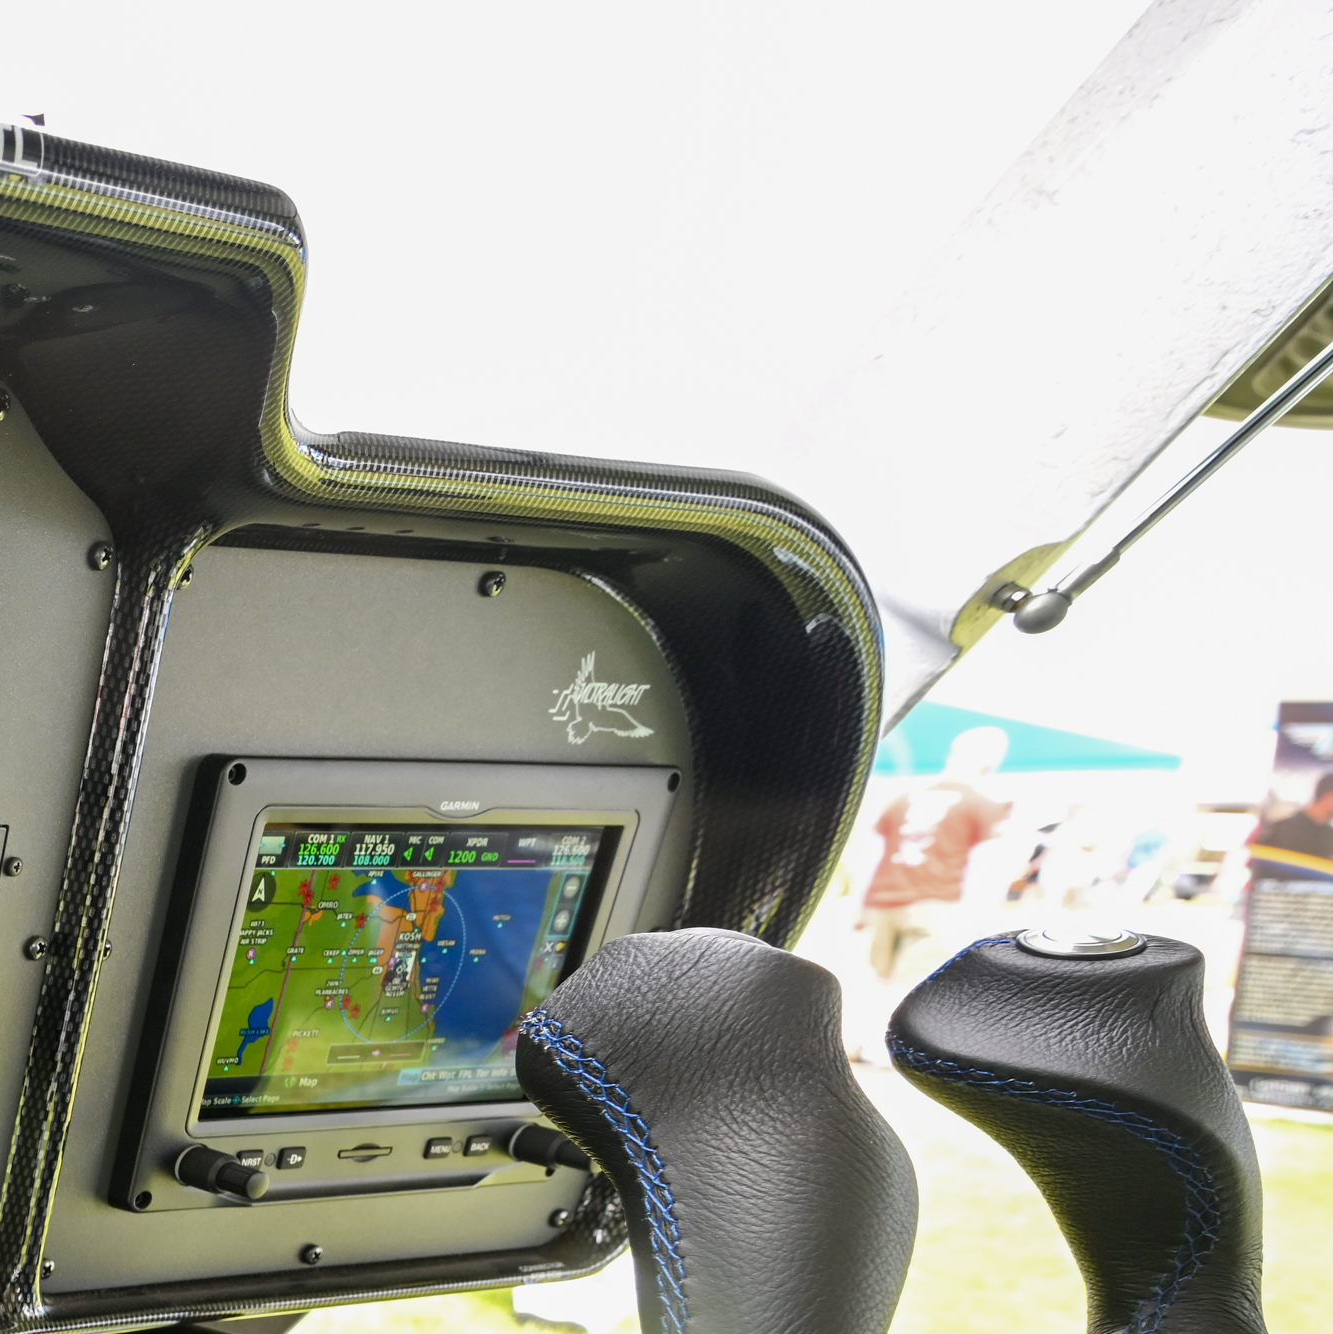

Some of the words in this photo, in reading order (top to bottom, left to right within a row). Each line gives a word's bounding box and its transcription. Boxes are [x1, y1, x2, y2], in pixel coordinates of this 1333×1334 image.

[440, 801, 480, 811] GARMIN
[308, 834, 329, 843] COM
[364, 834, 382, 843] NAV
[466, 837, 489, 847] XPDR
[298, 843, 340, 855] 126.600
[354, 844, 395, 855] 117.950
[261, 856, 276, 864] PFD
[297, 855, 335, 866] 120.700
[353, 855, 390, 866] 108.000
[448, 850, 477, 863] 1200
[481, 852, 499, 862] GND
[399, 933, 421, 941] KOSH
[299, 1077, 318, 1088] Map
[241, 1155, 262, 1168] NRST
